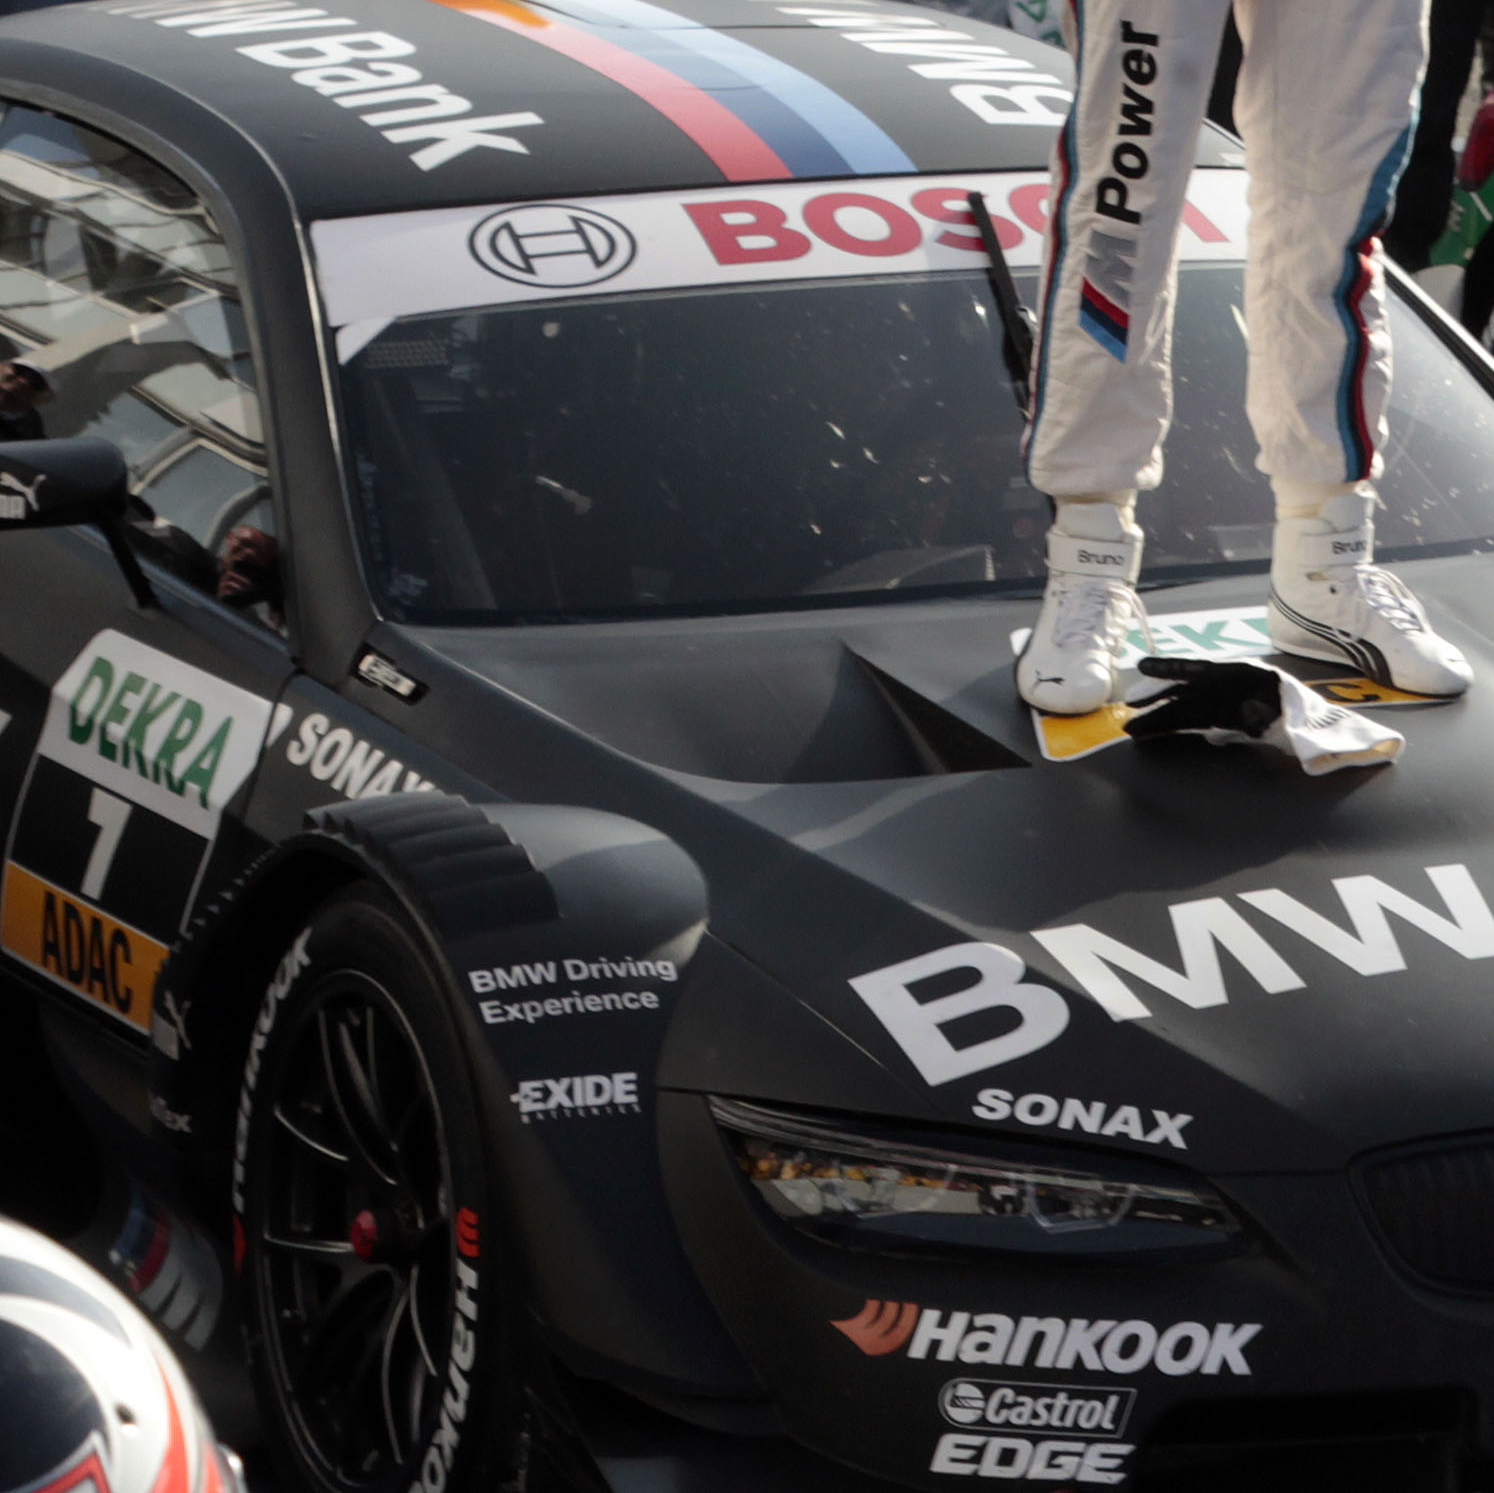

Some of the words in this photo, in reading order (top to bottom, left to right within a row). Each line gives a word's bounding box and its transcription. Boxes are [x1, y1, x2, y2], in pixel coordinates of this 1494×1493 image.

[234, 31, 545, 172] Bank
[1097, 19, 1160, 225] Power
[68, 656, 236, 809] DEKRA
[39, 892, 134, 1017] ADAC
[468, 959, 557, 995] BMW
[564, 954, 677, 984] Driving
[478, 986, 660, 1024] Experience
[512, 1071, 639, 1112] EXIDE
[971, 1088, 1194, 1149] SONAX
[982, 1387, 1121, 1432] Castrol
[930, 1435, 1137, 1485] EDGE
